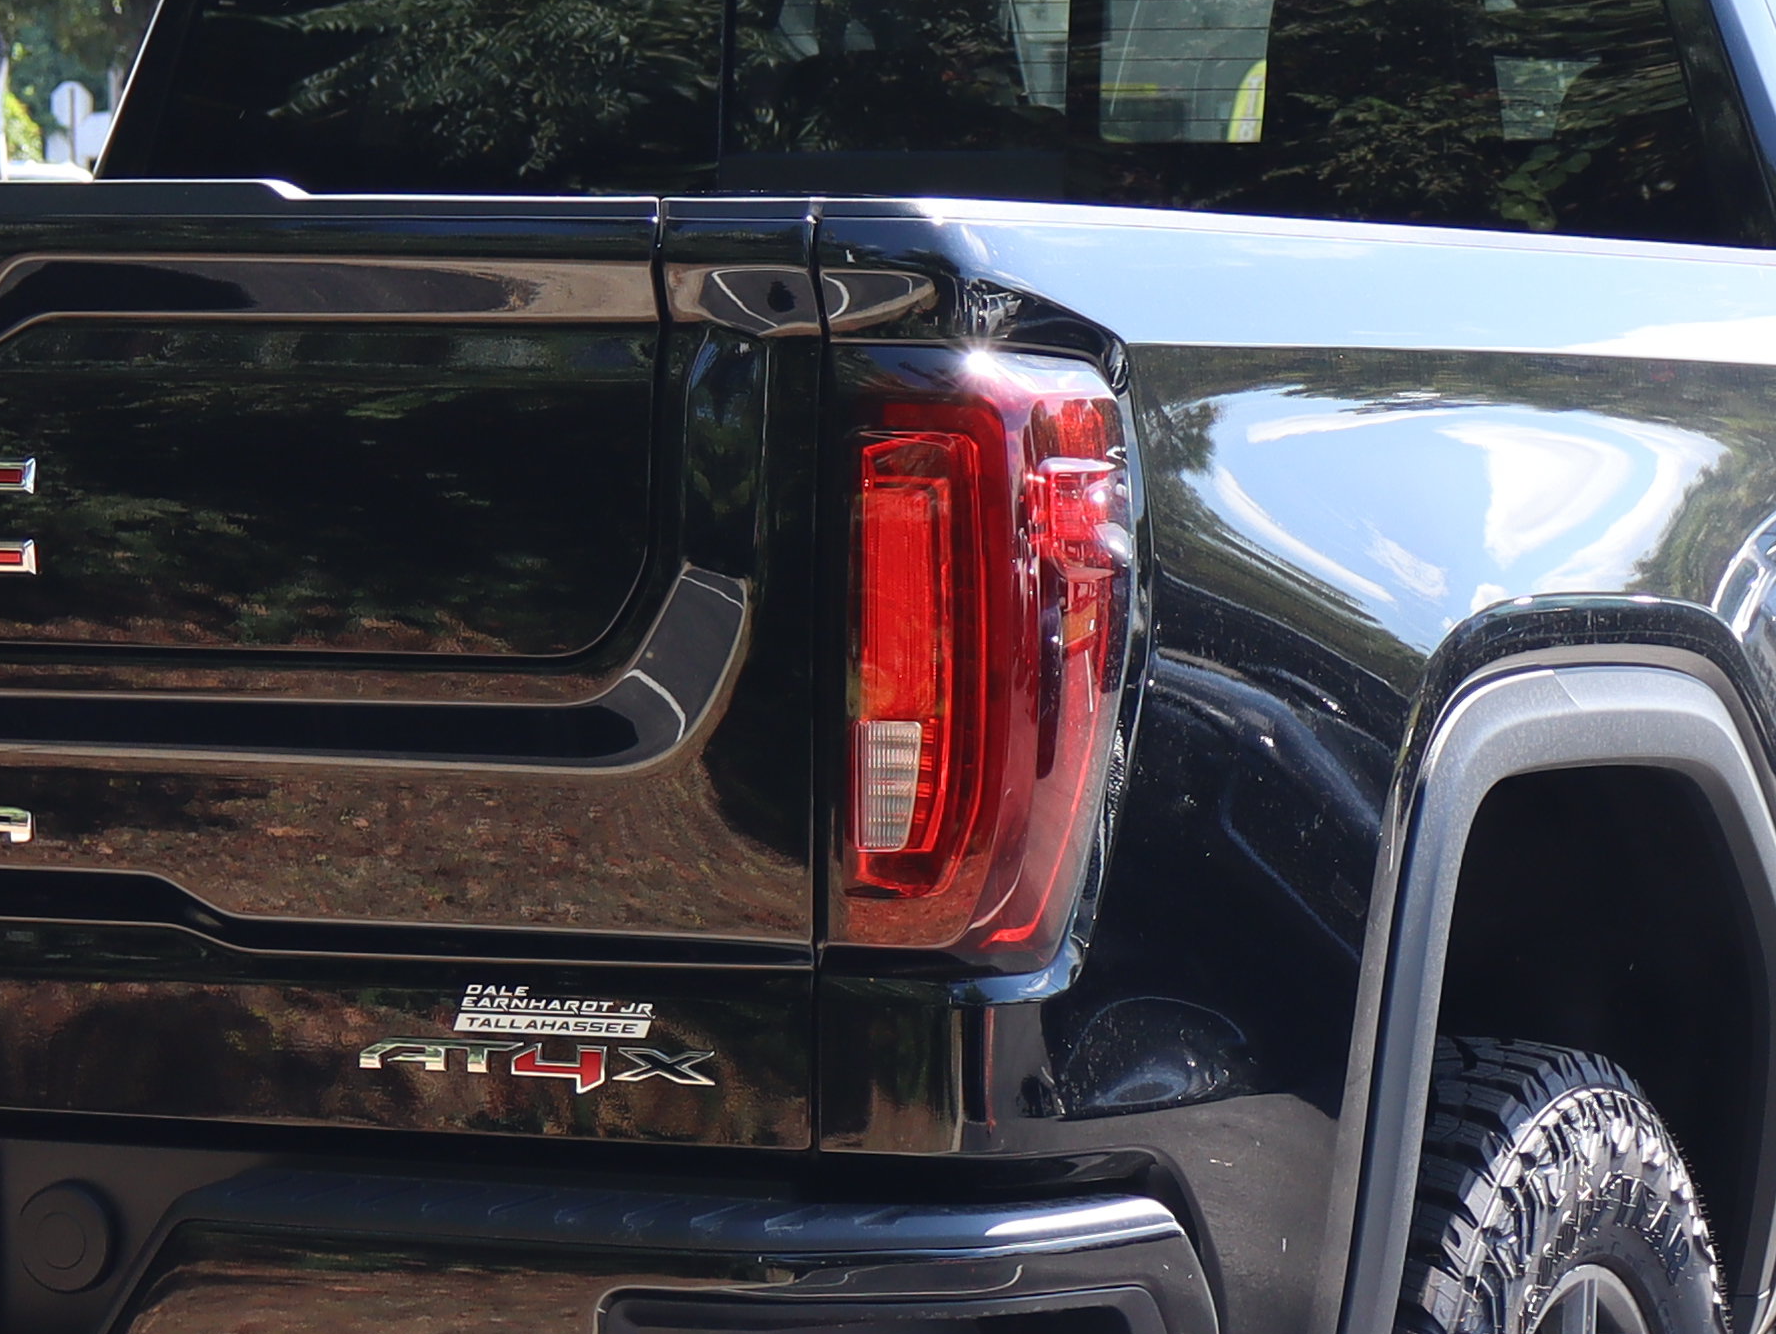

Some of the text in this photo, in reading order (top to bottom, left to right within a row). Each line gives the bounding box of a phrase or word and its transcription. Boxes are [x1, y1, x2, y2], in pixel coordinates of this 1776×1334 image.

[465, 984, 529, 996] DALE
[461, 996, 613, 1014] EARNHARDT
[466, 1016, 639, 1034] TALLAHASSEE
[359, 1036, 716, 1094] AT4X
